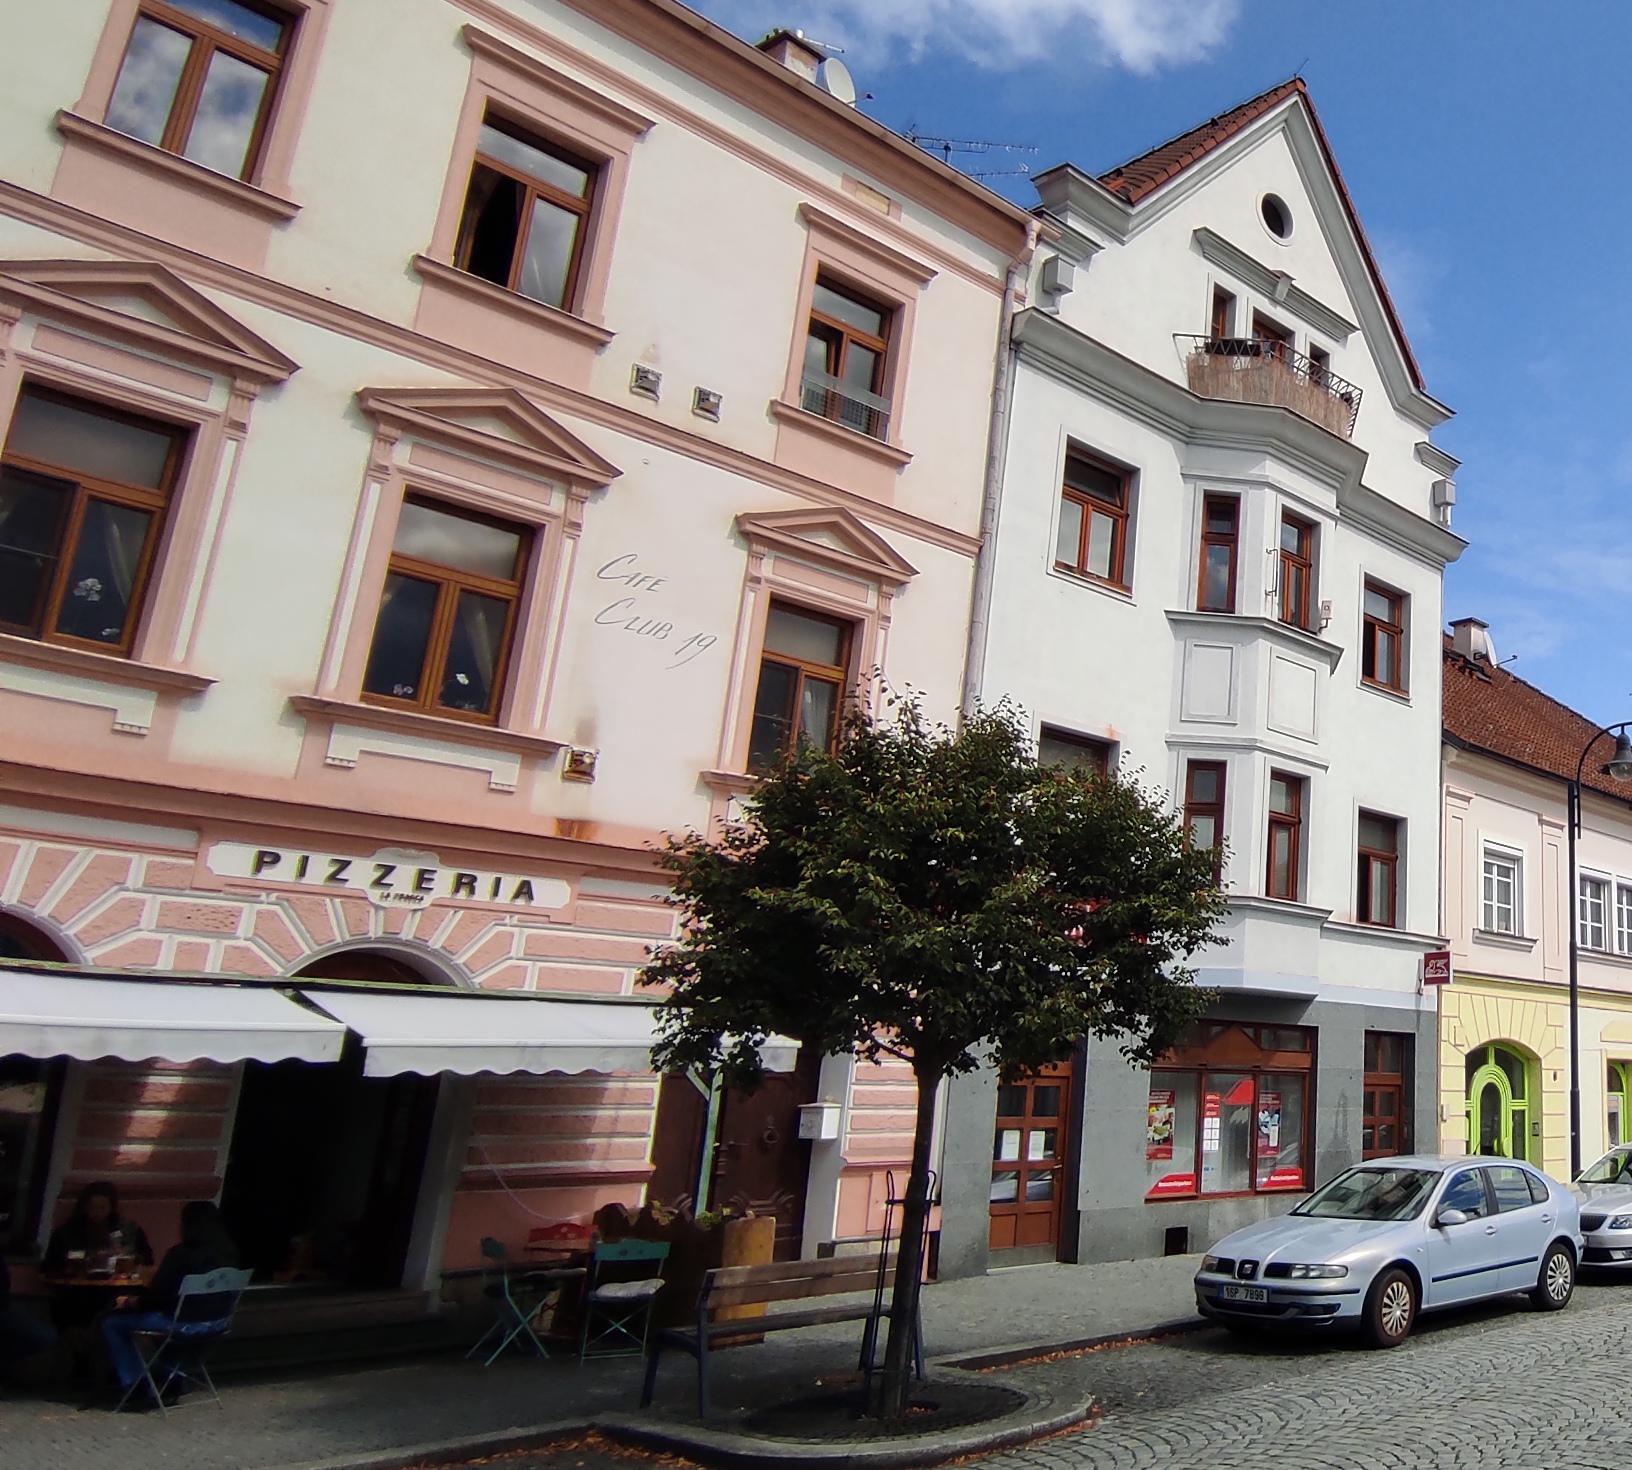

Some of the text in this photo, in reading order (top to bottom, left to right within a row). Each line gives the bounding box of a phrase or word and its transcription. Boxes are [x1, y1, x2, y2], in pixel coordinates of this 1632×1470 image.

[594, 597, 718, 670] CLUB 19
[252, 850, 535, 904] PIZZERIA
